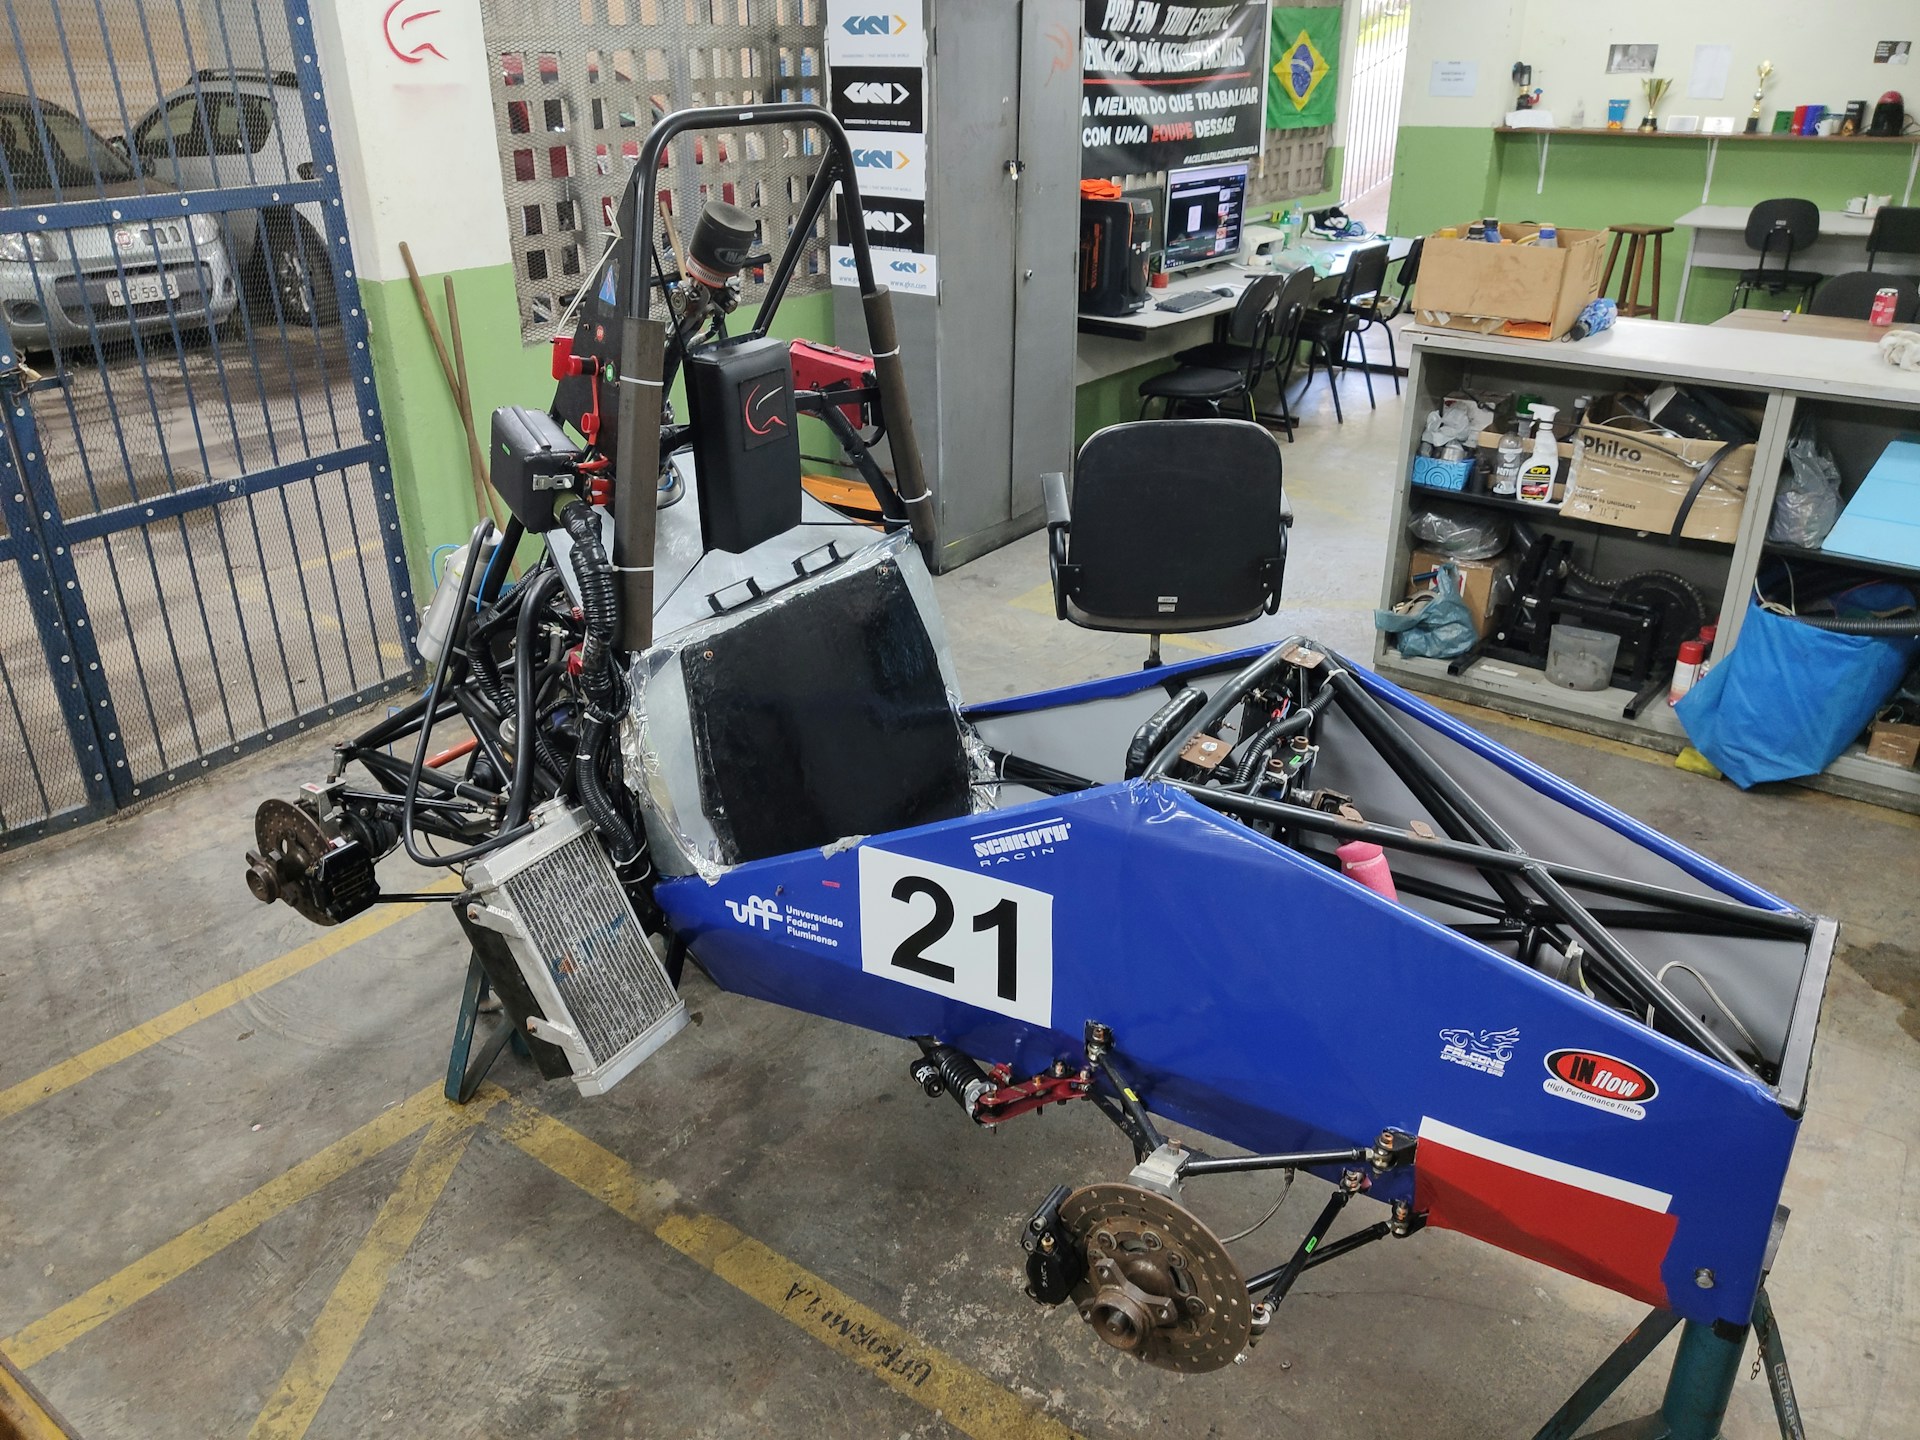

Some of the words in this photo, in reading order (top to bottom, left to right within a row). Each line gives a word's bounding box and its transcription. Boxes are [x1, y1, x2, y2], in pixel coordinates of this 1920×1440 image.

[842, 15, 889, 35] GKN
[1101, 0, 1135, 31] POR
[1129, 1, 1161, 34] FIM
[1159, 5, 1197, 36] TODO
[843, 82, 892, 104] GKN
[1094, 96, 1149, 117] MELHOR
[1150, 95, 1167, 115] DO
[1169, 93, 1194, 113] QUE
[1195, 87, 1259, 110] TRABALHAR
[1082, 126, 1112, 148] COM
[1115, 125, 1148, 145] UMA
[1151, 122, 1194, 143] EQUIPE
[1195, 116, 1237, 139] DESSAS!
[890, 261, 917, 274] GKN
[1583, 434, 1642, 462] Philco
[973, 824, 1070, 858] SCHROTH
[980, 847, 1055, 868] RACIN
[785, 905, 844, 928] Universidade
[785, 915, 819, 932] Federal
[786, 926, 838, 947] Fluminense
[890, 876, 1018, 1002] 21
[1443, 1044, 1506, 1071] FALCONS
[1547, 1081, 1564, 1093] High
[1565, 1087, 1616, 1108] Performance
[1616, 1103, 1642, 1117] Filters
